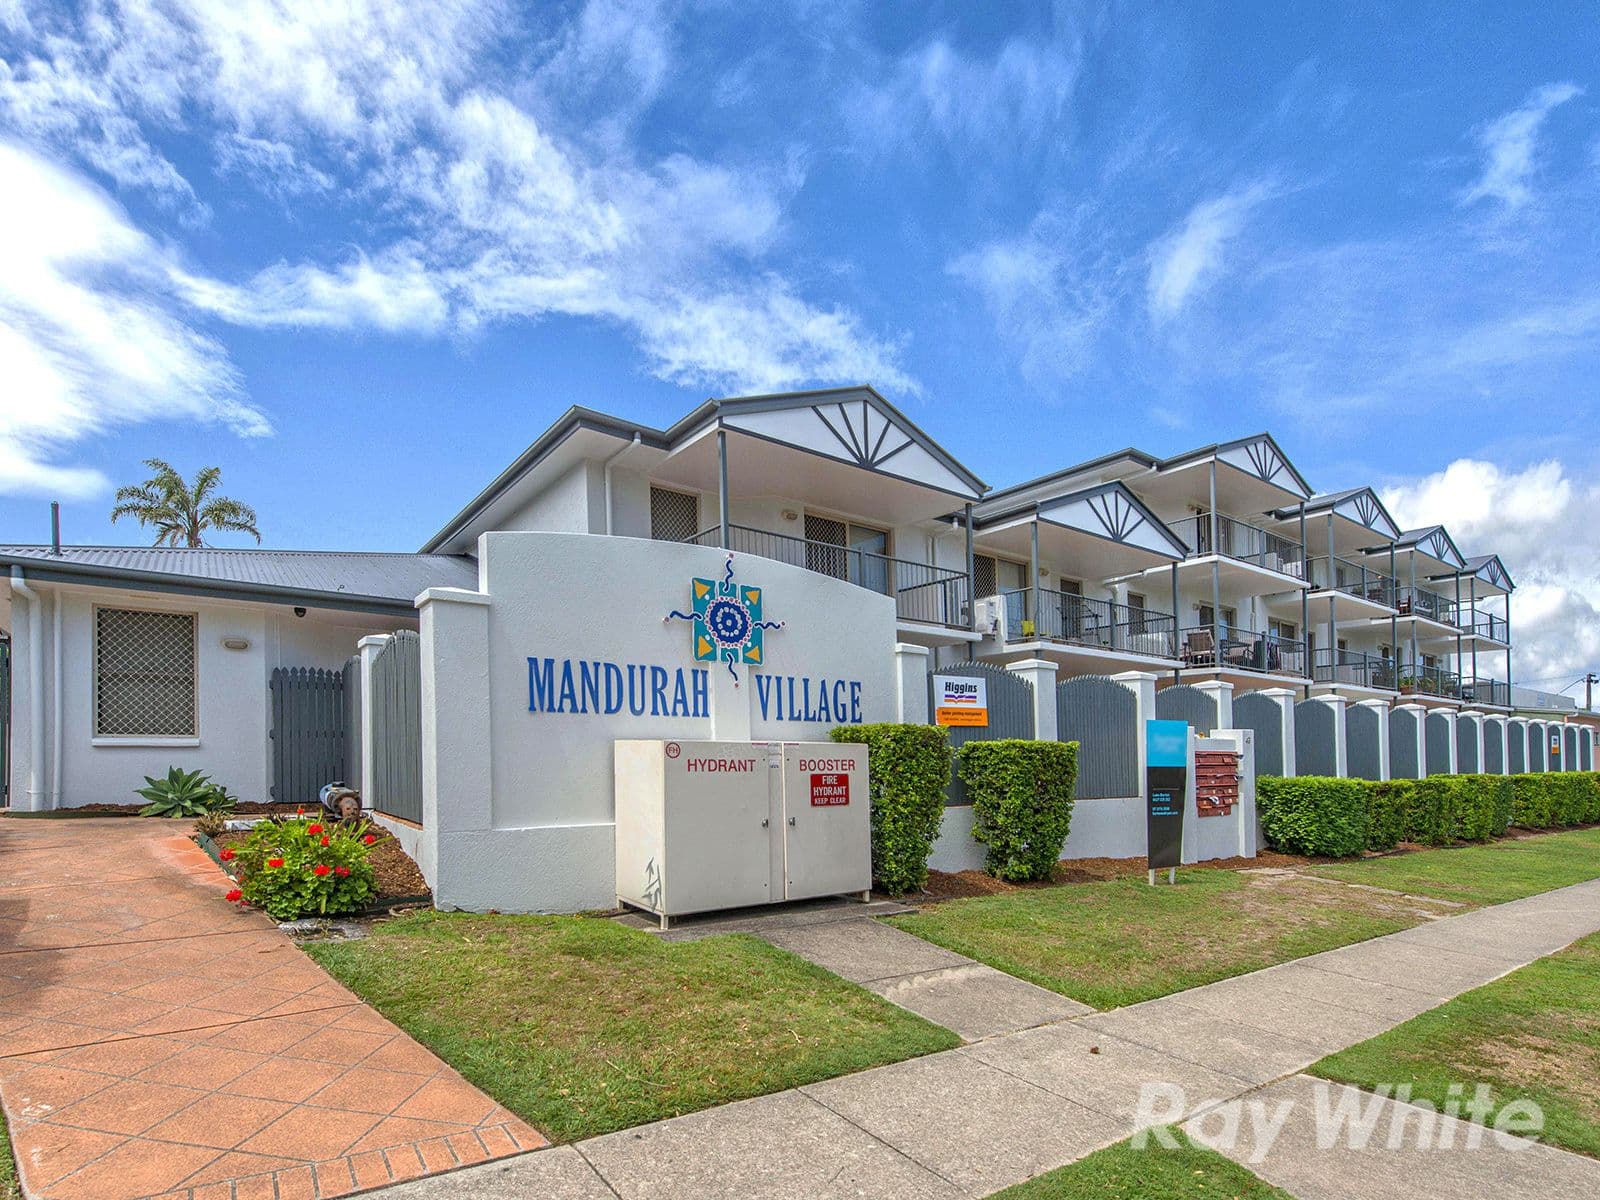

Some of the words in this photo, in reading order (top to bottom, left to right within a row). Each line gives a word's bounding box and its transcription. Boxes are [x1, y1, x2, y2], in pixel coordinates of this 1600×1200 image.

[527, 657, 710, 718] MANDURAH
[755, 674, 863, 724] VILLAGE
[945, 681, 978, 694] Higgins
[687, 759, 756, 772] HYDRANT
[800, 759, 856, 772] BOOSTER
[822, 775, 838, 785] FIRE
[813, 786, 846, 796] HYDRANT
